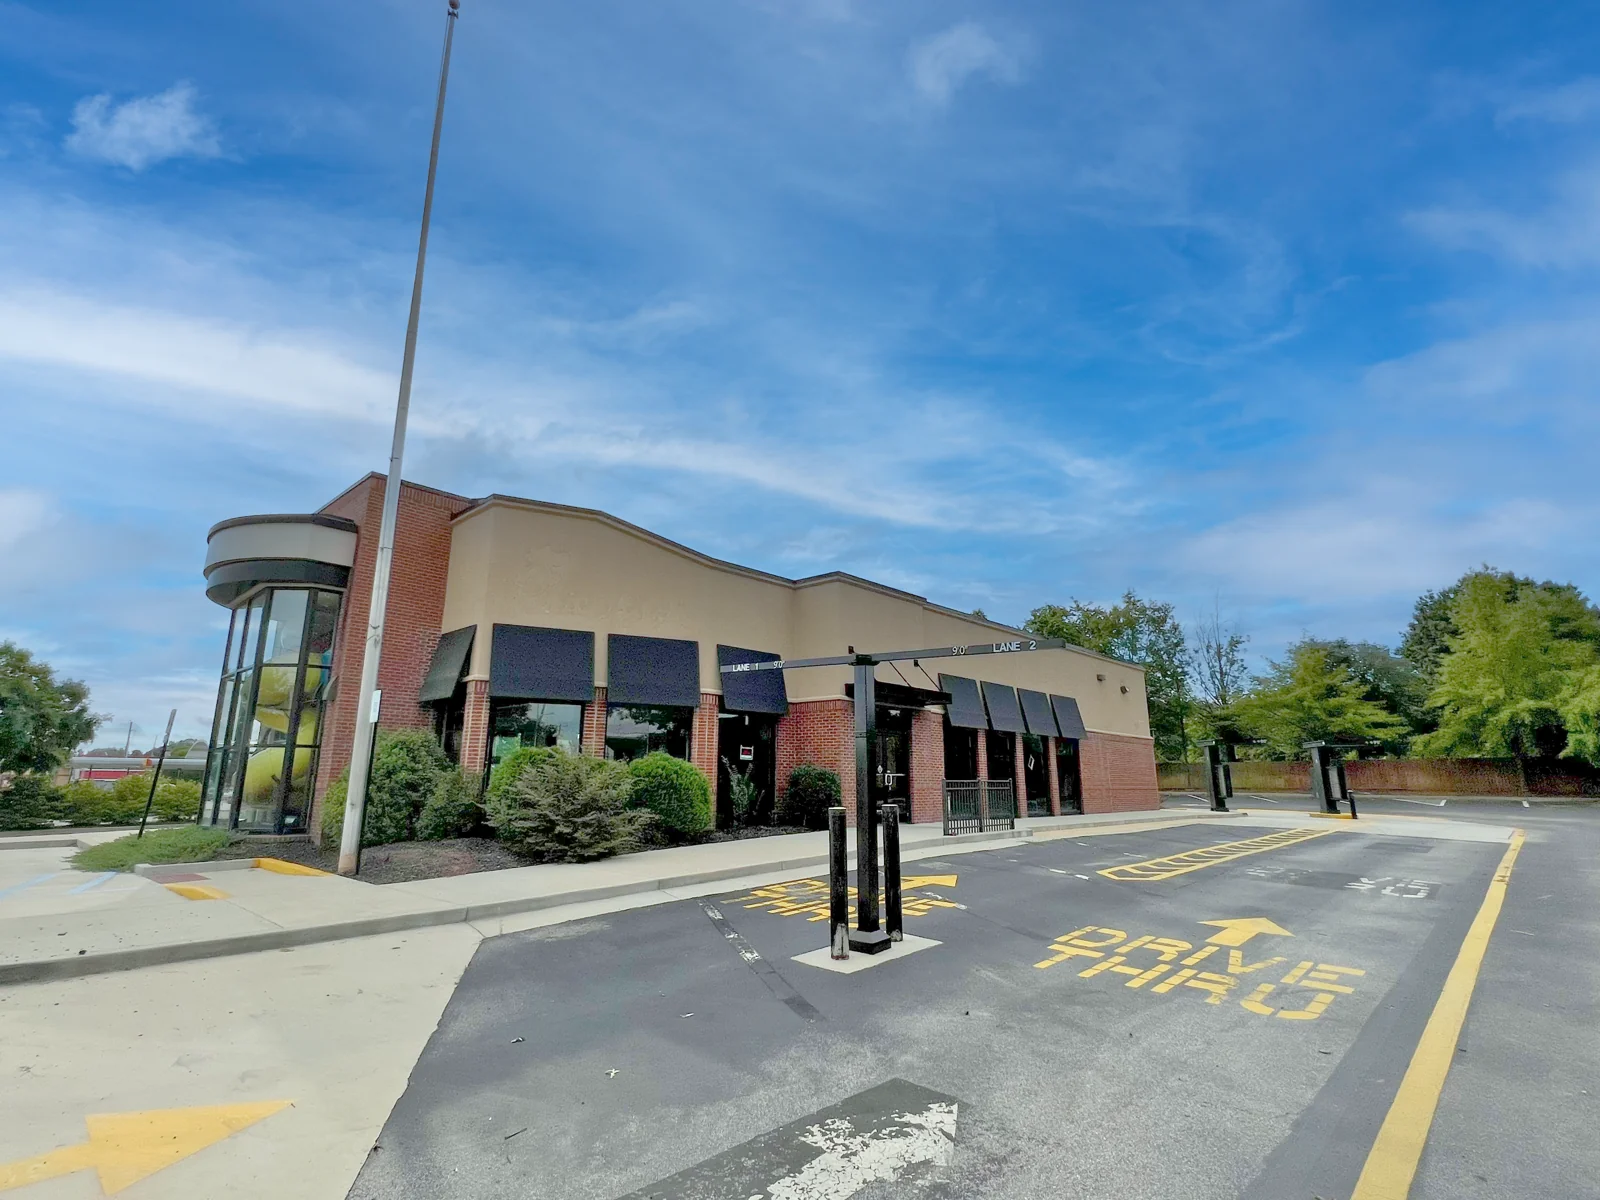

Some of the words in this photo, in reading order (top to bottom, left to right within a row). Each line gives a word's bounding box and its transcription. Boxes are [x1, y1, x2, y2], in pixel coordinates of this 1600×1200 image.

[993, 641, 1021, 653] LANE
[1029, 640, 1037, 650] 2
[732, 663, 750, 672] LANE
[754, 662, 759, 671] 1
[1054, 925, 1366, 993] DRIVE
[1033, 943, 1336, 1021] THRU
